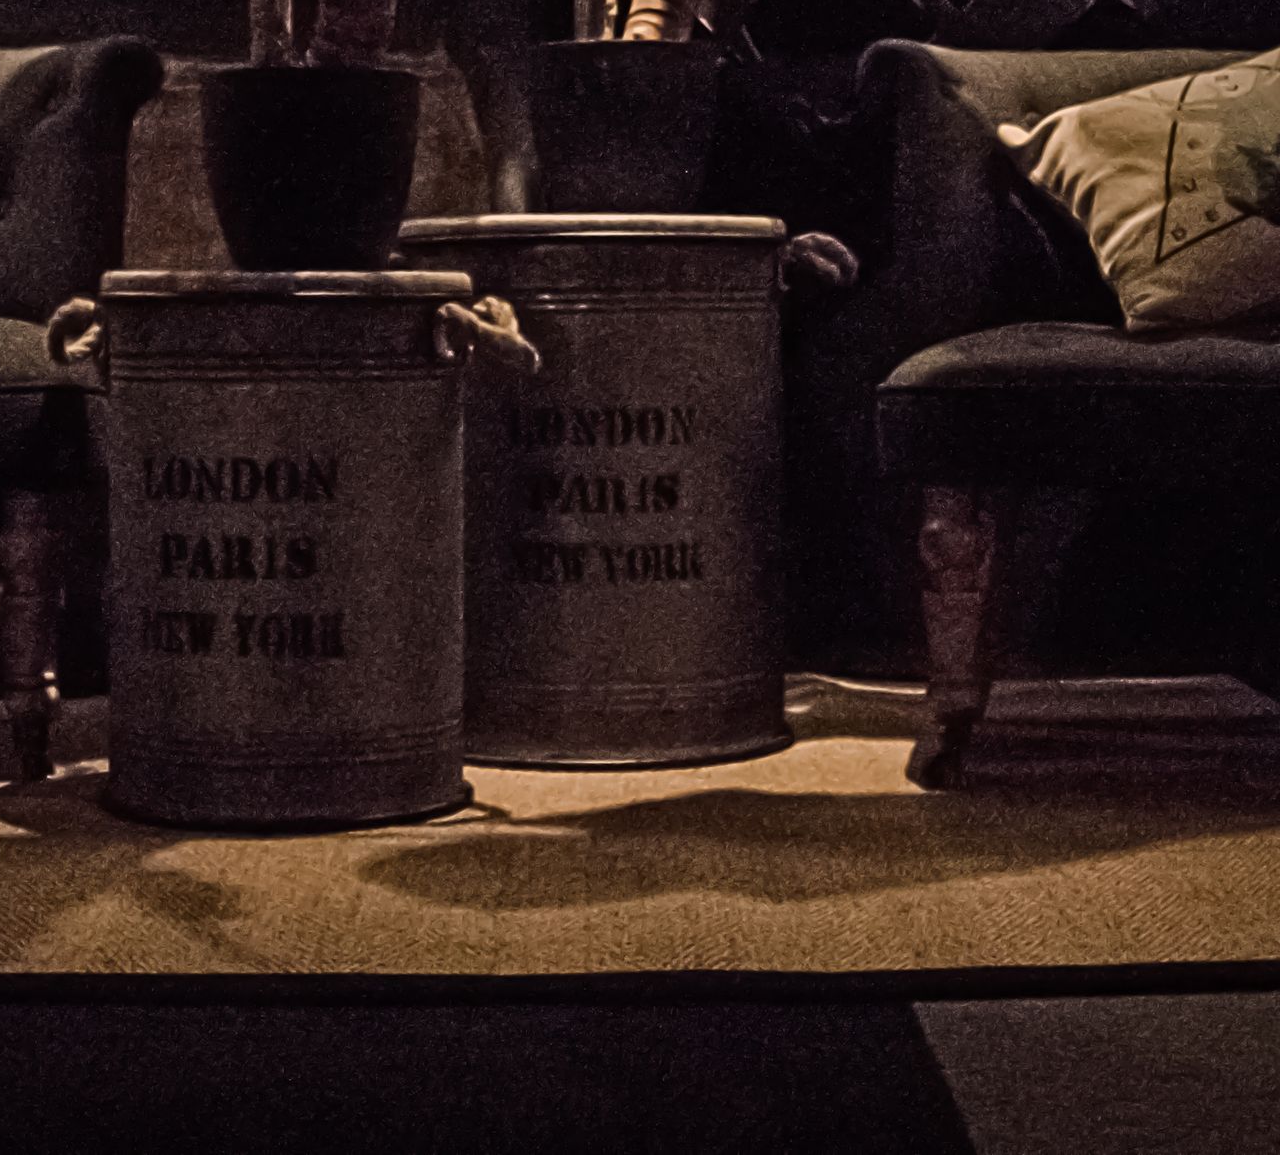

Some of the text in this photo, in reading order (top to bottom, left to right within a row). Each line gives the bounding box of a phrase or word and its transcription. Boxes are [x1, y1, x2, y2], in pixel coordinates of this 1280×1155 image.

[144, 456, 338, 502] LONDON
[526, 474, 678, 515] PARIS
[160, 533, 317, 580] PARIS
[597, 543, 704, 584] YORK
